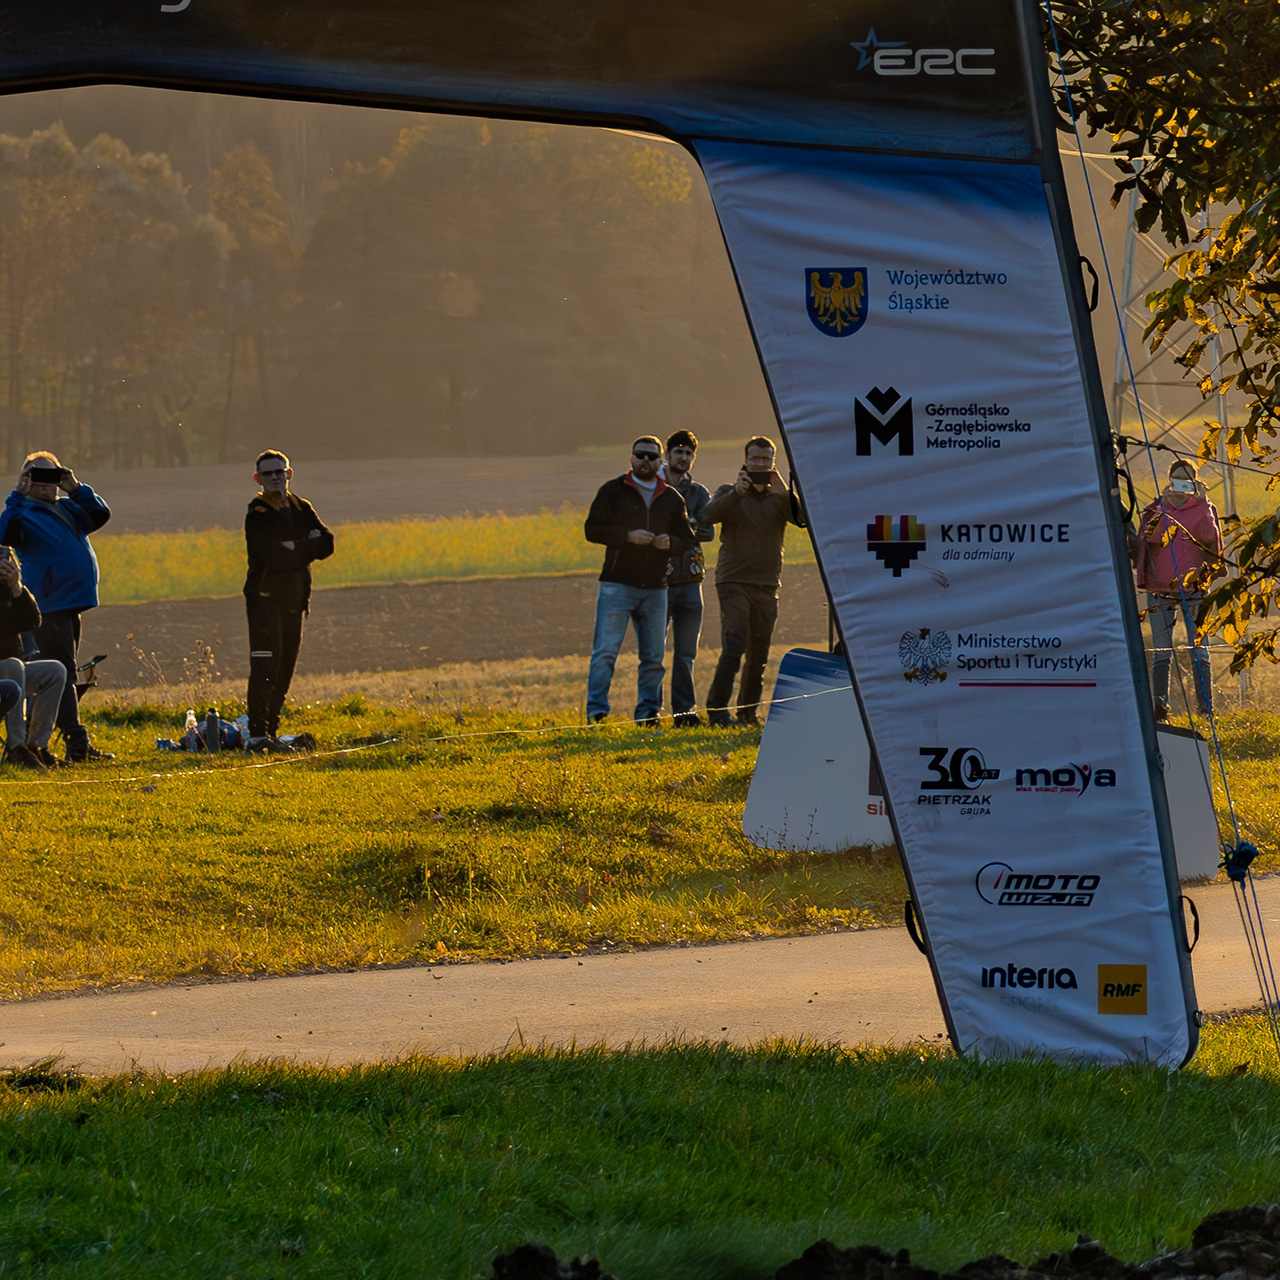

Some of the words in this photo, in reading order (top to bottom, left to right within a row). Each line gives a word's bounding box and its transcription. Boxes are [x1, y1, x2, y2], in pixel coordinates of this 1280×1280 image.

[886, 268, 1008, 289] Województwo
[887, 291, 950, 313] Śląskie
[925, 402, 1011, 419] Górnośląsko
[926, 435, 1002, 452] Metropolia
[940, 523, 1071, 545] KATOWICE
[941, 547, 960, 561] dla
[963, 547, 1016, 563] odmiany
[956, 632, 1062, 650] Ministerstwo
[956, 653, 1012, 674] Sportu
[1015, 653, 1020, 670] i
[1026, 653, 1098, 674] Turystyki
[1015, 762, 1117, 798] moya
[917, 794, 992, 805] PIETRZAK
[959, 807, 992, 815] GRUPA
[1001, 894, 1091, 905] WIZJA
[981, 962, 1079, 990] interia
[1102, 983, 1143, 998] RMF
